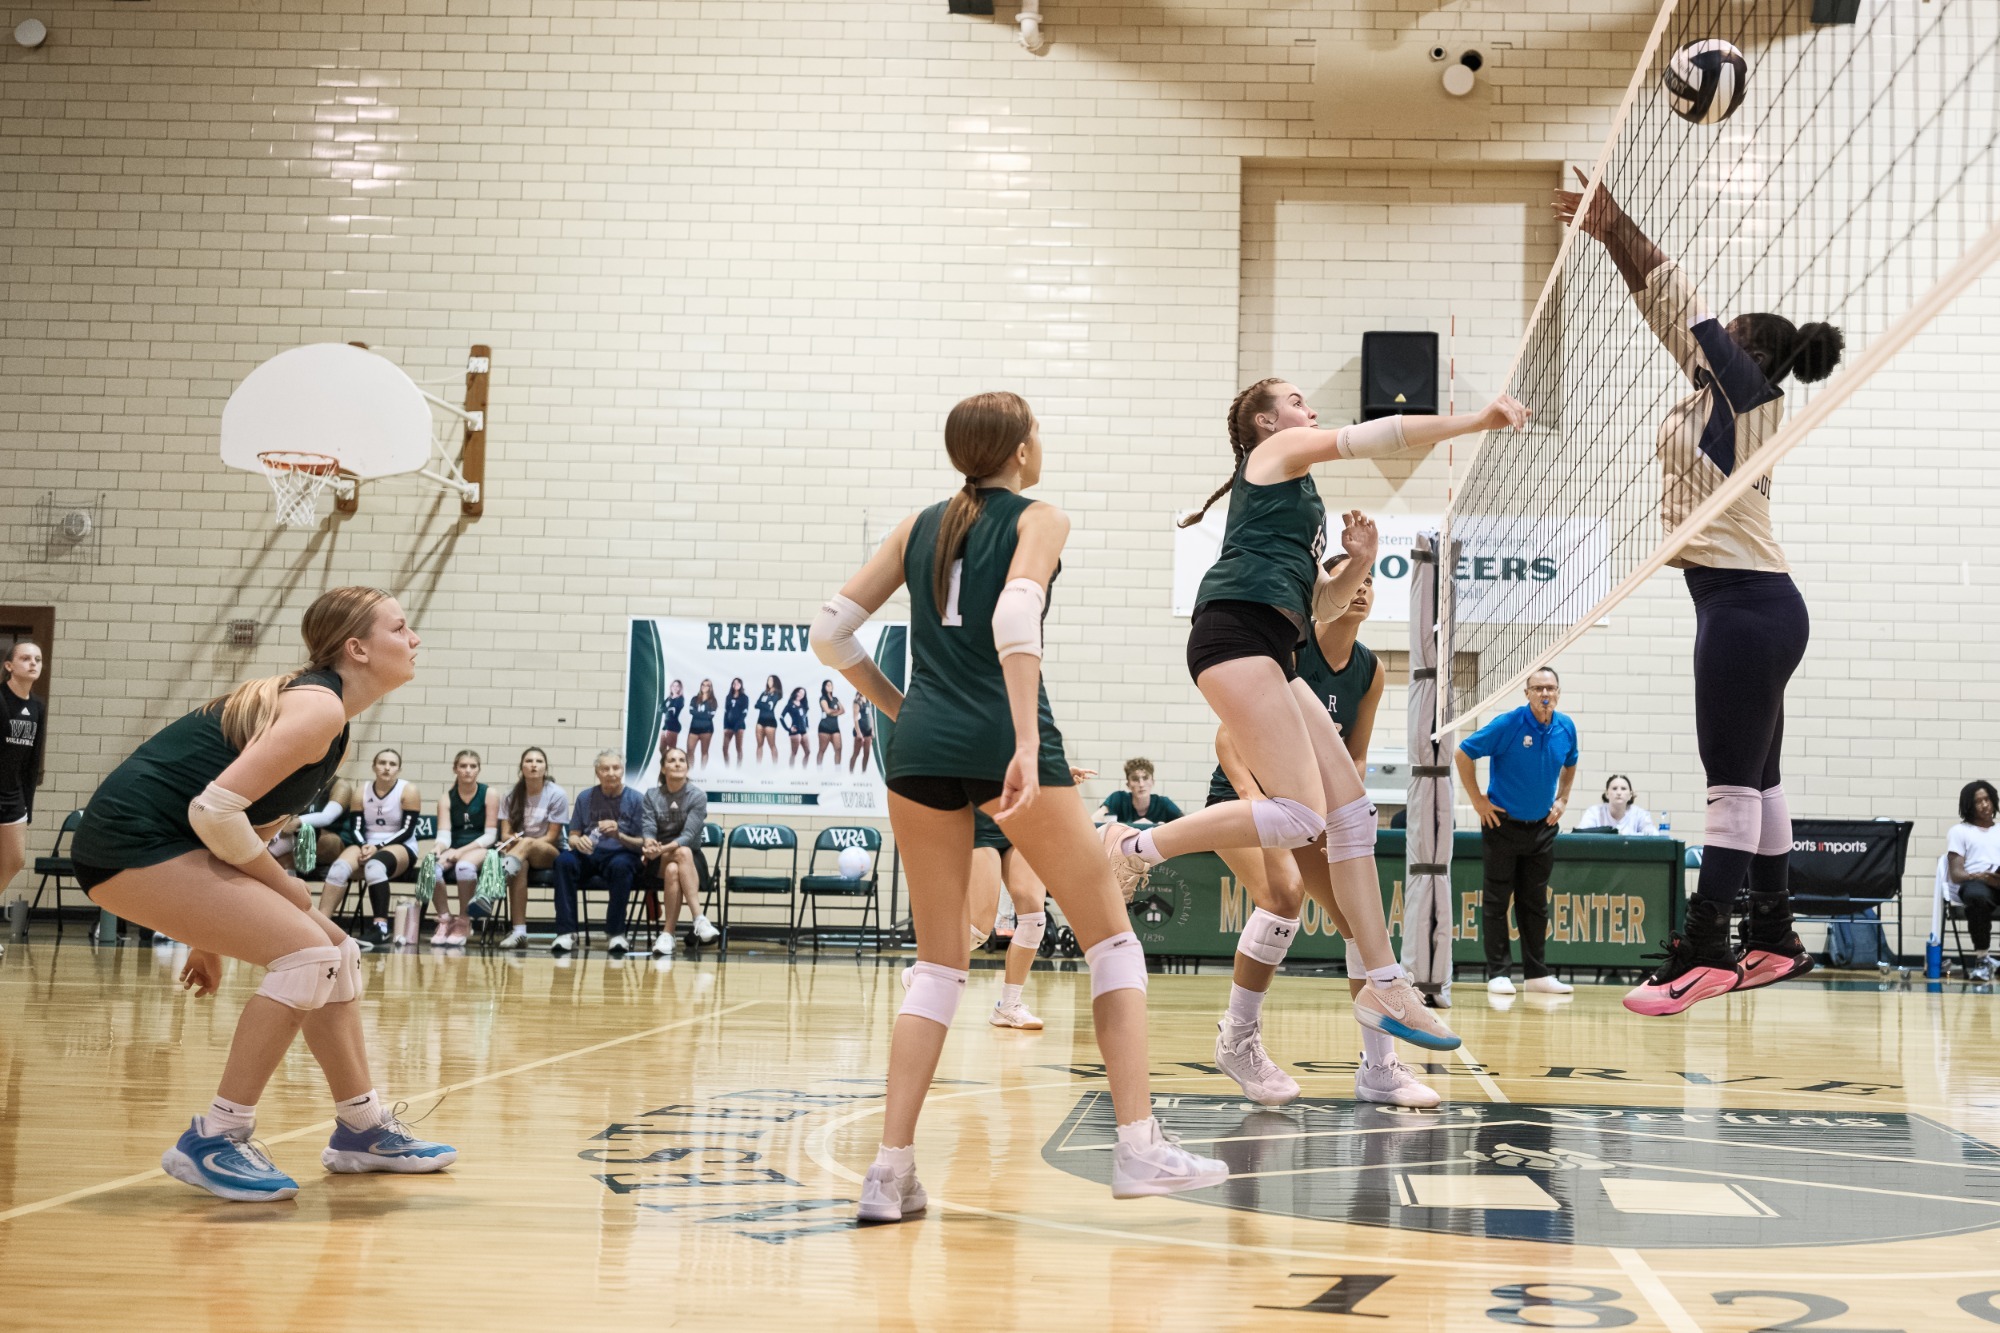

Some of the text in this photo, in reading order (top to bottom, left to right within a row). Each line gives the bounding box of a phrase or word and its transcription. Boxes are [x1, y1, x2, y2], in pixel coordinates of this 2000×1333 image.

[706, 622, 812, 652] RESERV
[1327, 694, 1338, 713] R
[414, 817, 434, 837] RA
[744, 826, 784, 846] WRA
[829, 828, 869, 848] WRA
[1792, 839, 1817, 853] orts
